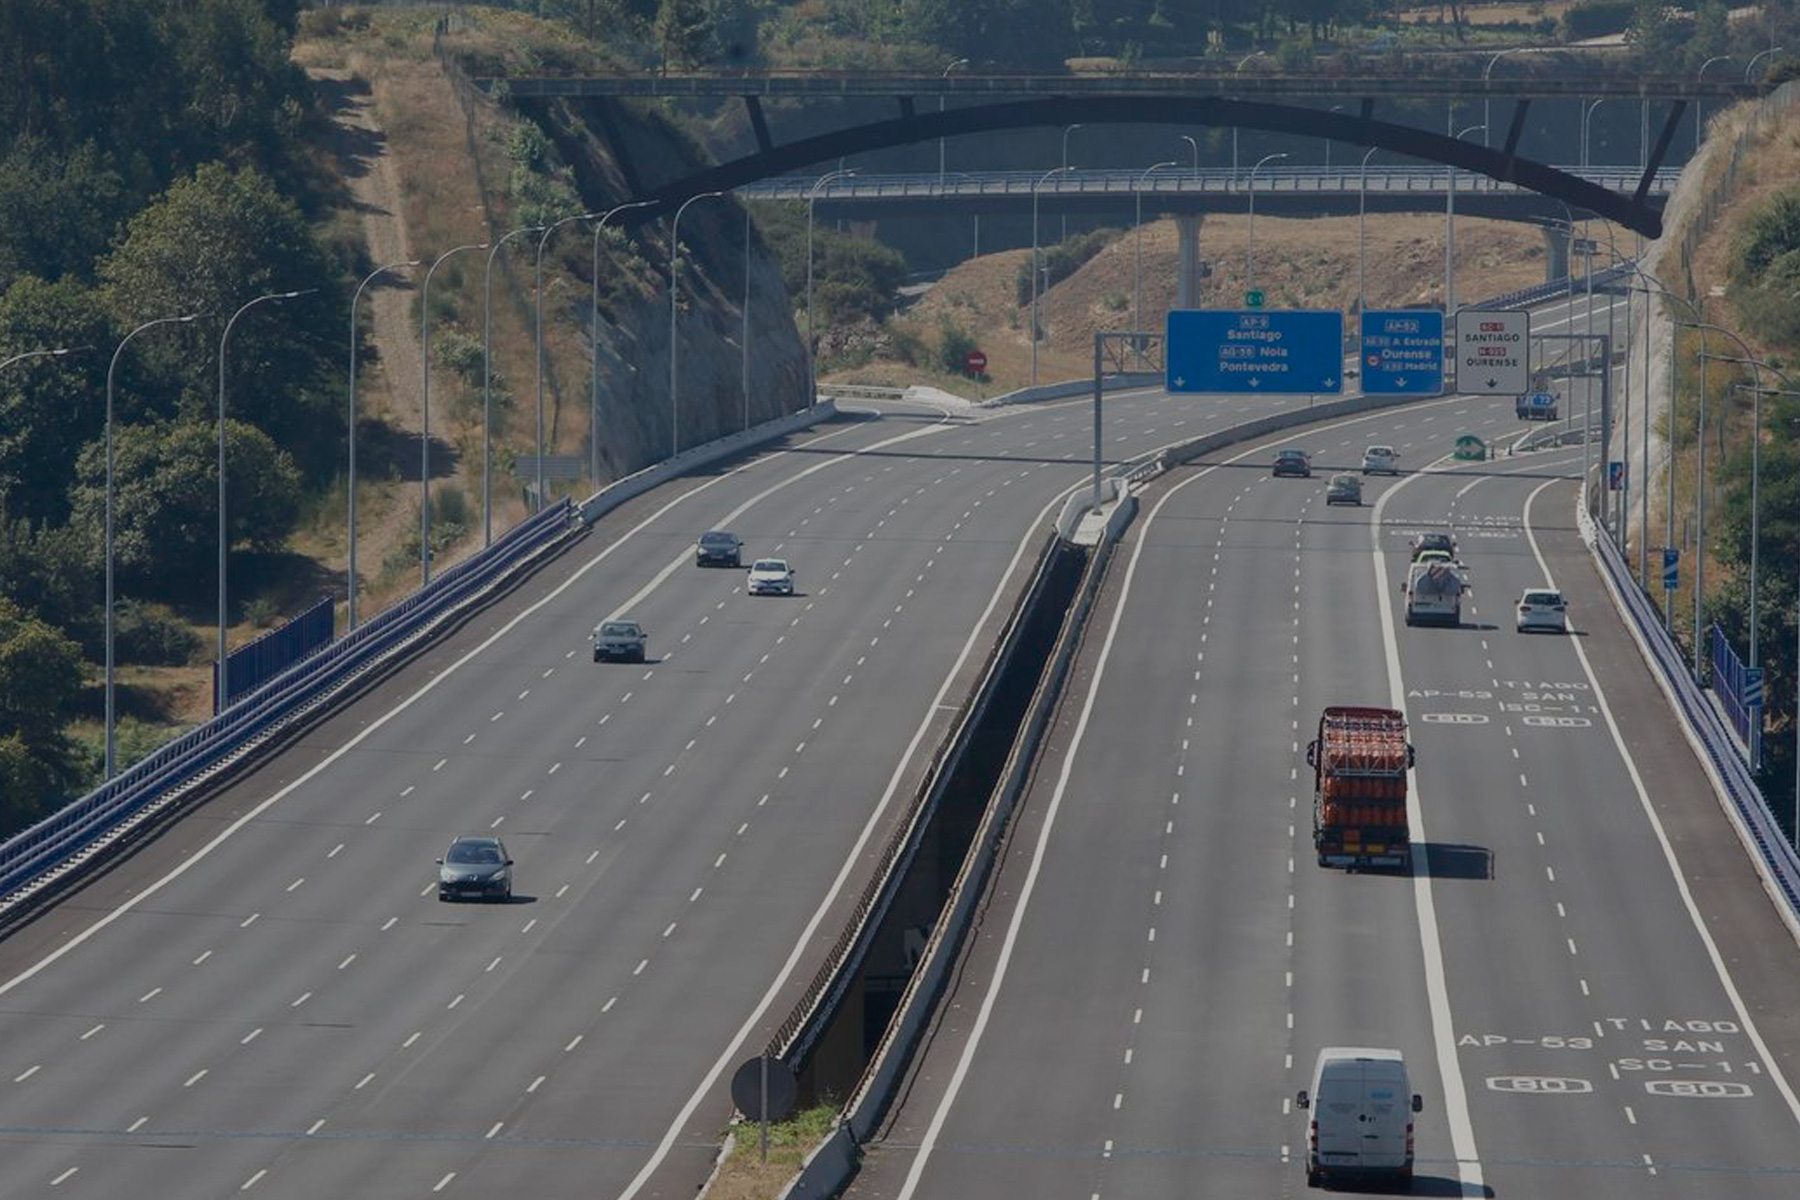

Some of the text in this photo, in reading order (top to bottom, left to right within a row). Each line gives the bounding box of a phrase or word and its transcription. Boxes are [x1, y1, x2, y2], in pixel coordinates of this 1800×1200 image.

[1227, 330, 1282, 342] Santiago
[1465, 333, 1520, 343] SANTIAGO
[1382, 349, 1432, 359] Ourense
[1219, 361, 1288, 372] Pontevedra
[1467, 358, 1518, 367] OURENSE
[1408, 690, 1492, 699] AP-53
[1523, 691, 1575, 701] SAN
[1458, 1033, 1593, 1049] AP-53
[1643, 1039, 1724, 1053] SAN
[1619, 1058, 1761, 1074] SC-11
